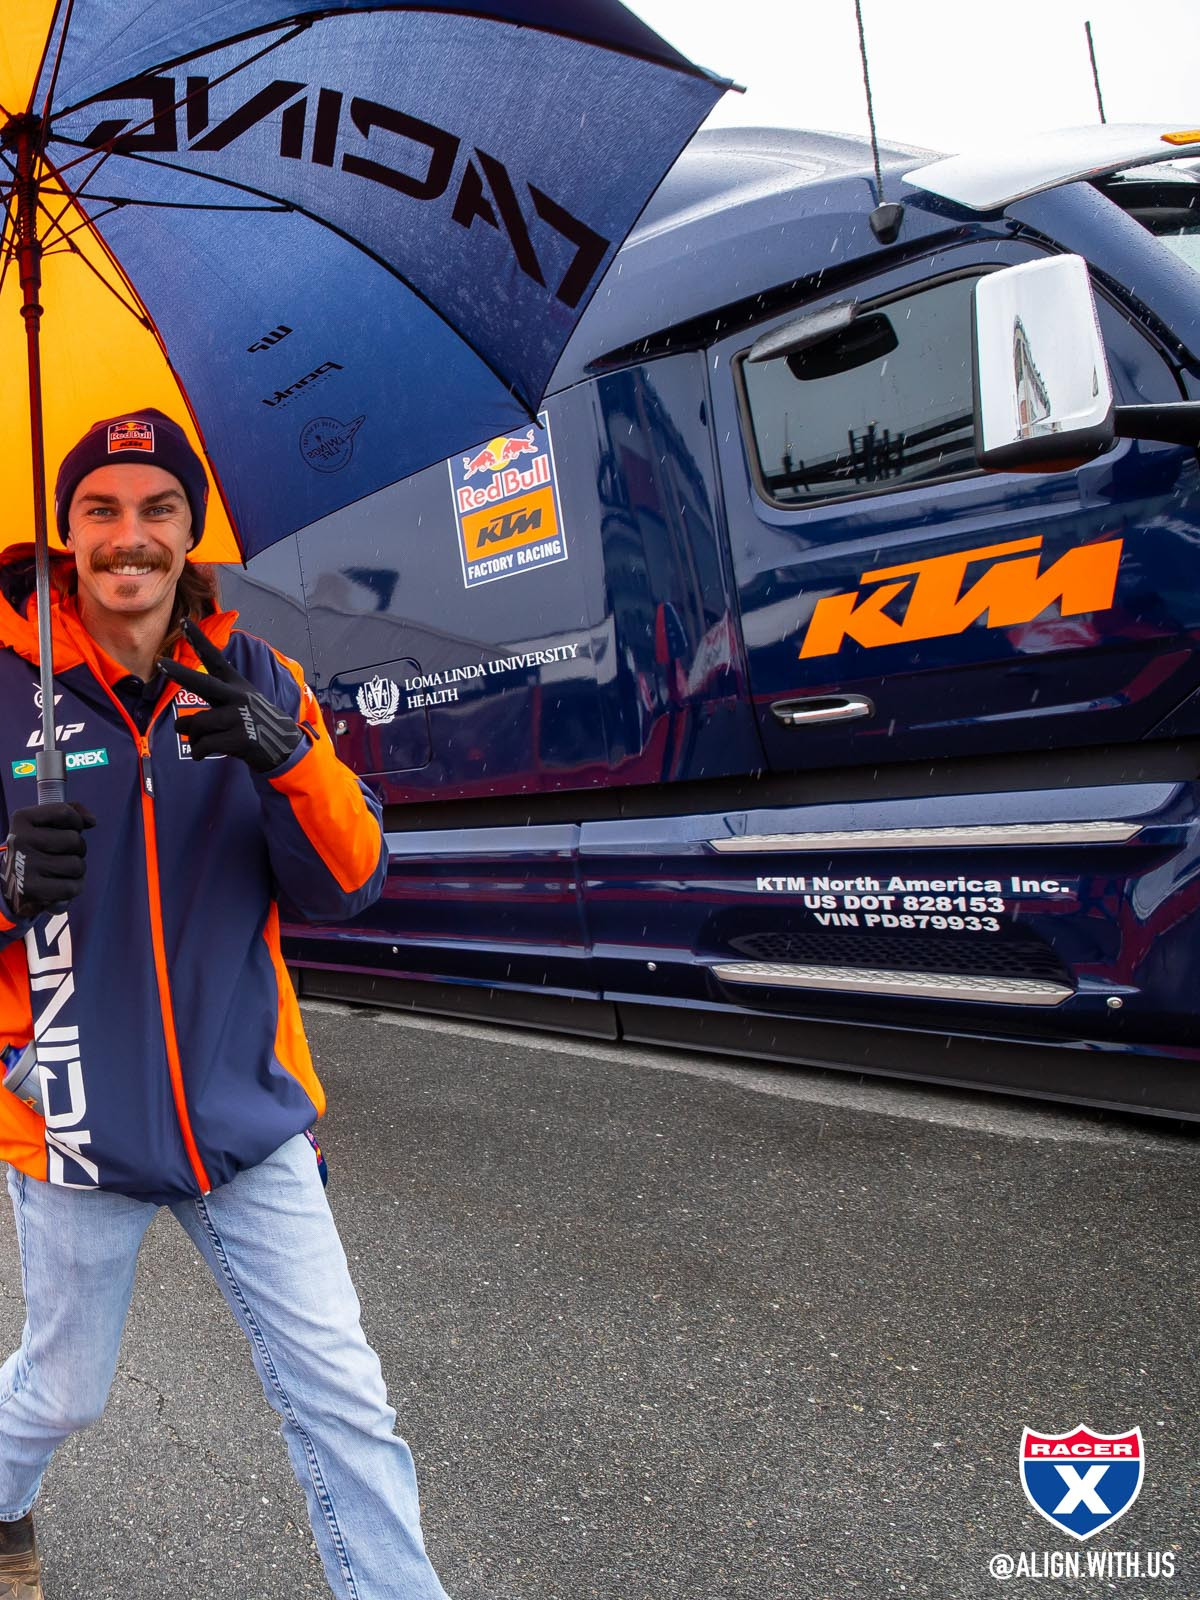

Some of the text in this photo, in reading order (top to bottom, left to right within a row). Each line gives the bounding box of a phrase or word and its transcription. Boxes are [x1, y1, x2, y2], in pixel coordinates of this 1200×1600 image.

[111, 431, 152, 440] Red Bull
[457, 454, 550, 513] Red Bull
[476, 508, 542, 548] KTM
[467, 540, 562, 580] FACTORY RACING
[798, 535, 1124, 659] KTM
[404, 643, 578, 691] LOMA LINDA UNIVERSITY
[407, 688, 459, 709] HEALTH
[238, 705, 258, 741] THOR
[65, 751, 104, 768] OREX
[756, 876, 1070, 893] KTM North America Inc.
[803, 895, 1006, 913] US DOT 828153
[814, 912, 1000, 932] VIN PD879933
